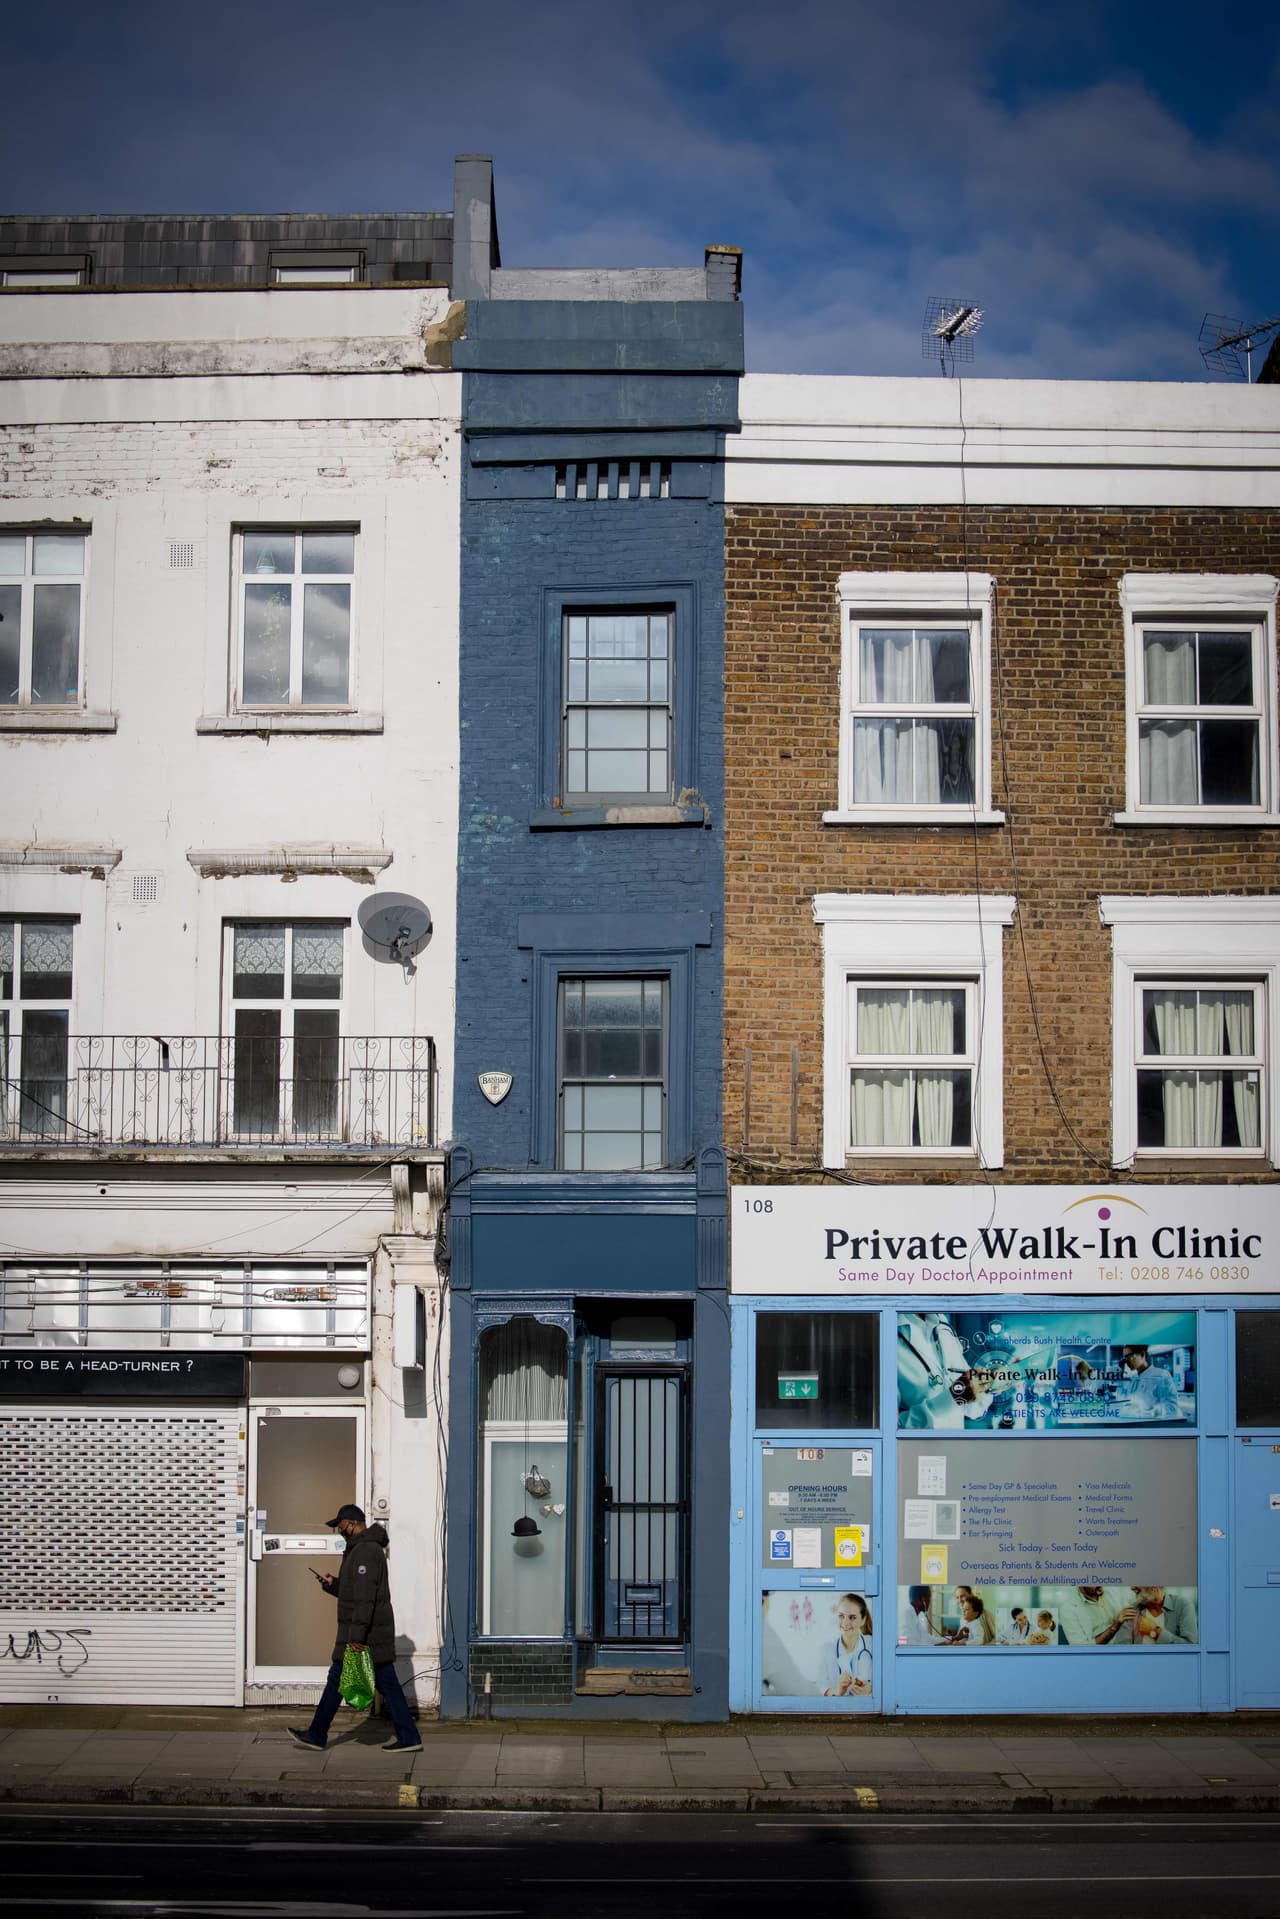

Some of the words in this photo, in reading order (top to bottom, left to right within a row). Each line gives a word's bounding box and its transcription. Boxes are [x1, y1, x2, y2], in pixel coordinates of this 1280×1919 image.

[482, 1076, 508, 1084] BANHAM
[744, 1199, 774, 1213] 108
[824, 1228, 968, 1260] Private
[977, 1226, 1138, 1259] Walk-In
[1152, 1226, 1262, 1259] Clinic
[838, 1268, 879, 1282] Same
[886, 1268, 915, 1285] Day
[922, 1268, 971, 1282] Doctor
[977, 1268, 1073, 1284] Appointment
[1098, 1266, 1123, 1280] Tel:
[1130, 1266, 1170, 1280] 0208
[1176, 1266, 1204, 1280] 746
[1210, 1266, 1250, 1280] 0830
[1034, 1336, 1052, 1345] Bush
[1056, 1336, 1082, 1345] Health
[1085, 1336, 1112, 1345] Centre
[16, 1360, 34, 1370] TO
[40, 1360, 60, 1370] BE
[65, 1361, 74, 1370] A
[80, 1361, 180, 1372] HEAD-TURNER
[186, 1360, 194, 1372] ?
[968, 1369, 1020, 1381] Private
[1024, 1368, 1081, 1381] Walk-In
[1087, 1368, 1127, 1381] Clinic
[1070, 1409, 1120, 1418] WELCOME
[800, 1448, 824, 1460] 108
[989, 1483, 1002, 1491] Day
[1018, 1544, 1043, 1553] Today
[1051, 1543, 1071, 1551] Seen
[1073, 1543, 1098, 1552] Today
[960, 1561, 998, 1570] Overseas
[1002, 1561, 1033, 1570] Patients
[1035, 1561, 1042, 1570] &
[1045, 1560, 1078, 1569] Students
[1081, 1560, 1096, 1569] Are
[1098, 1560, 1136, 1569] Welcome
[975, 1576, 996, 1584] Male
[999, 1576, 1005, 1584] &
[1008, 1576, 1037, 1584] Female
[1040, 1575, 1089, 1586] Multilingual
[1092, 1575, 1122, 1584] Doctors
